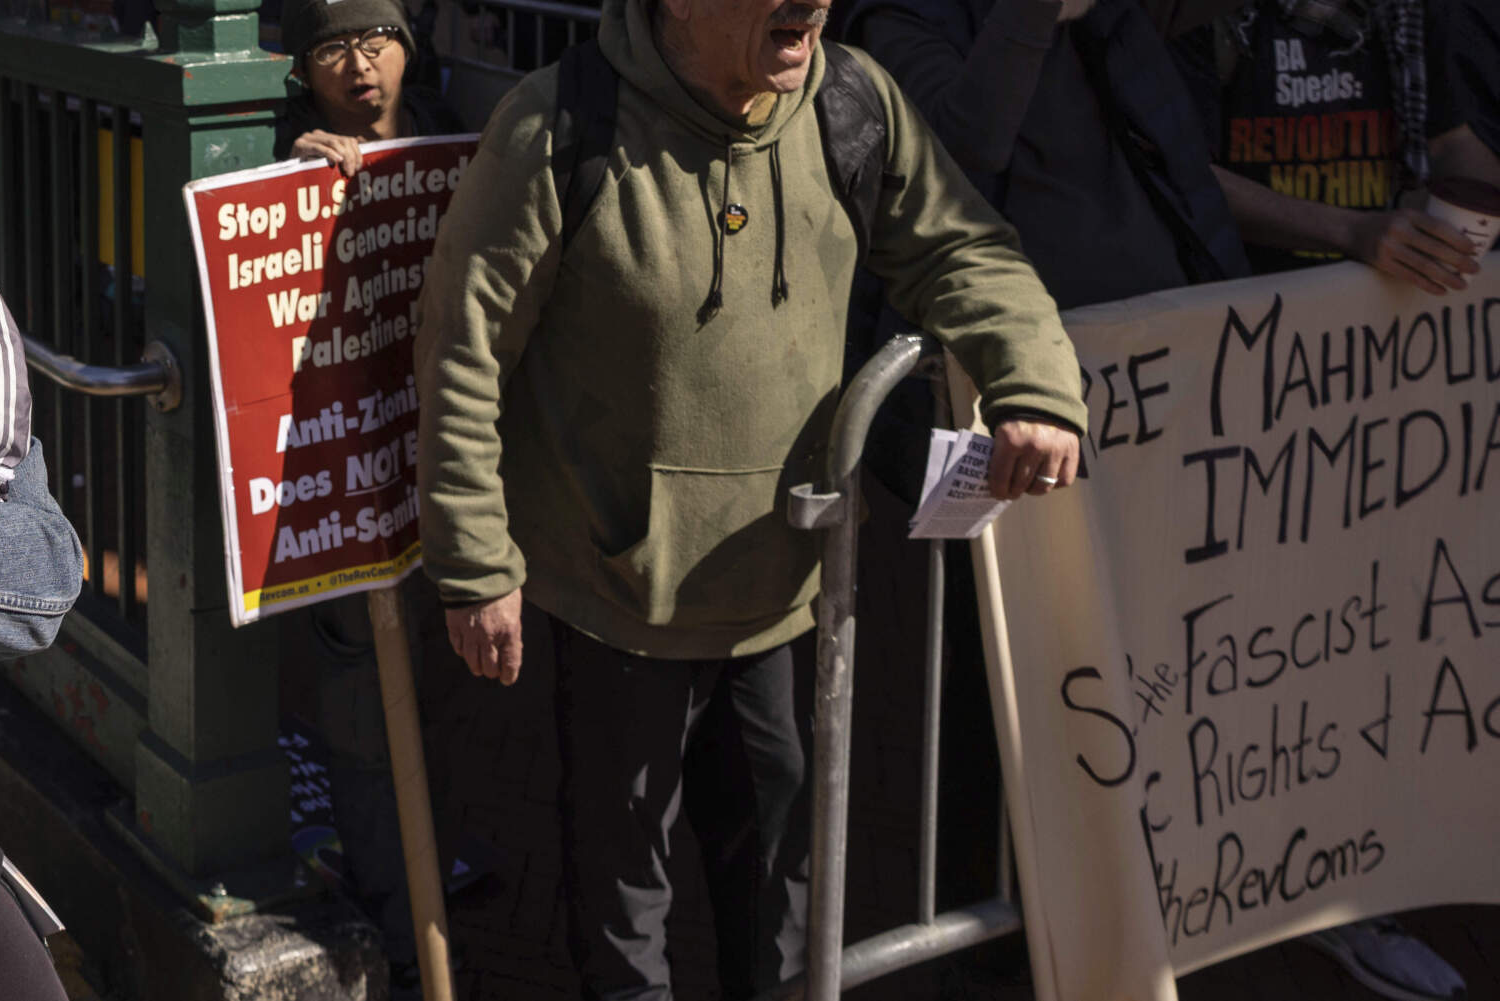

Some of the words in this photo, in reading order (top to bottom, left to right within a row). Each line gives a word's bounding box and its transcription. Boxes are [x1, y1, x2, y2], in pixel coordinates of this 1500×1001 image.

[1273, 37, 1308, 71] BA
[217, 202, 287, 241] Stop
[227, 231, 325, 291] Israeli
[335, 203, 444, 264] Genocid
[266, 286, 333, 329] War
[291, 300, 418, 374] Palestine!
[249, 469, 333, 516] Does
[346, 436, 402, 493] NOT
